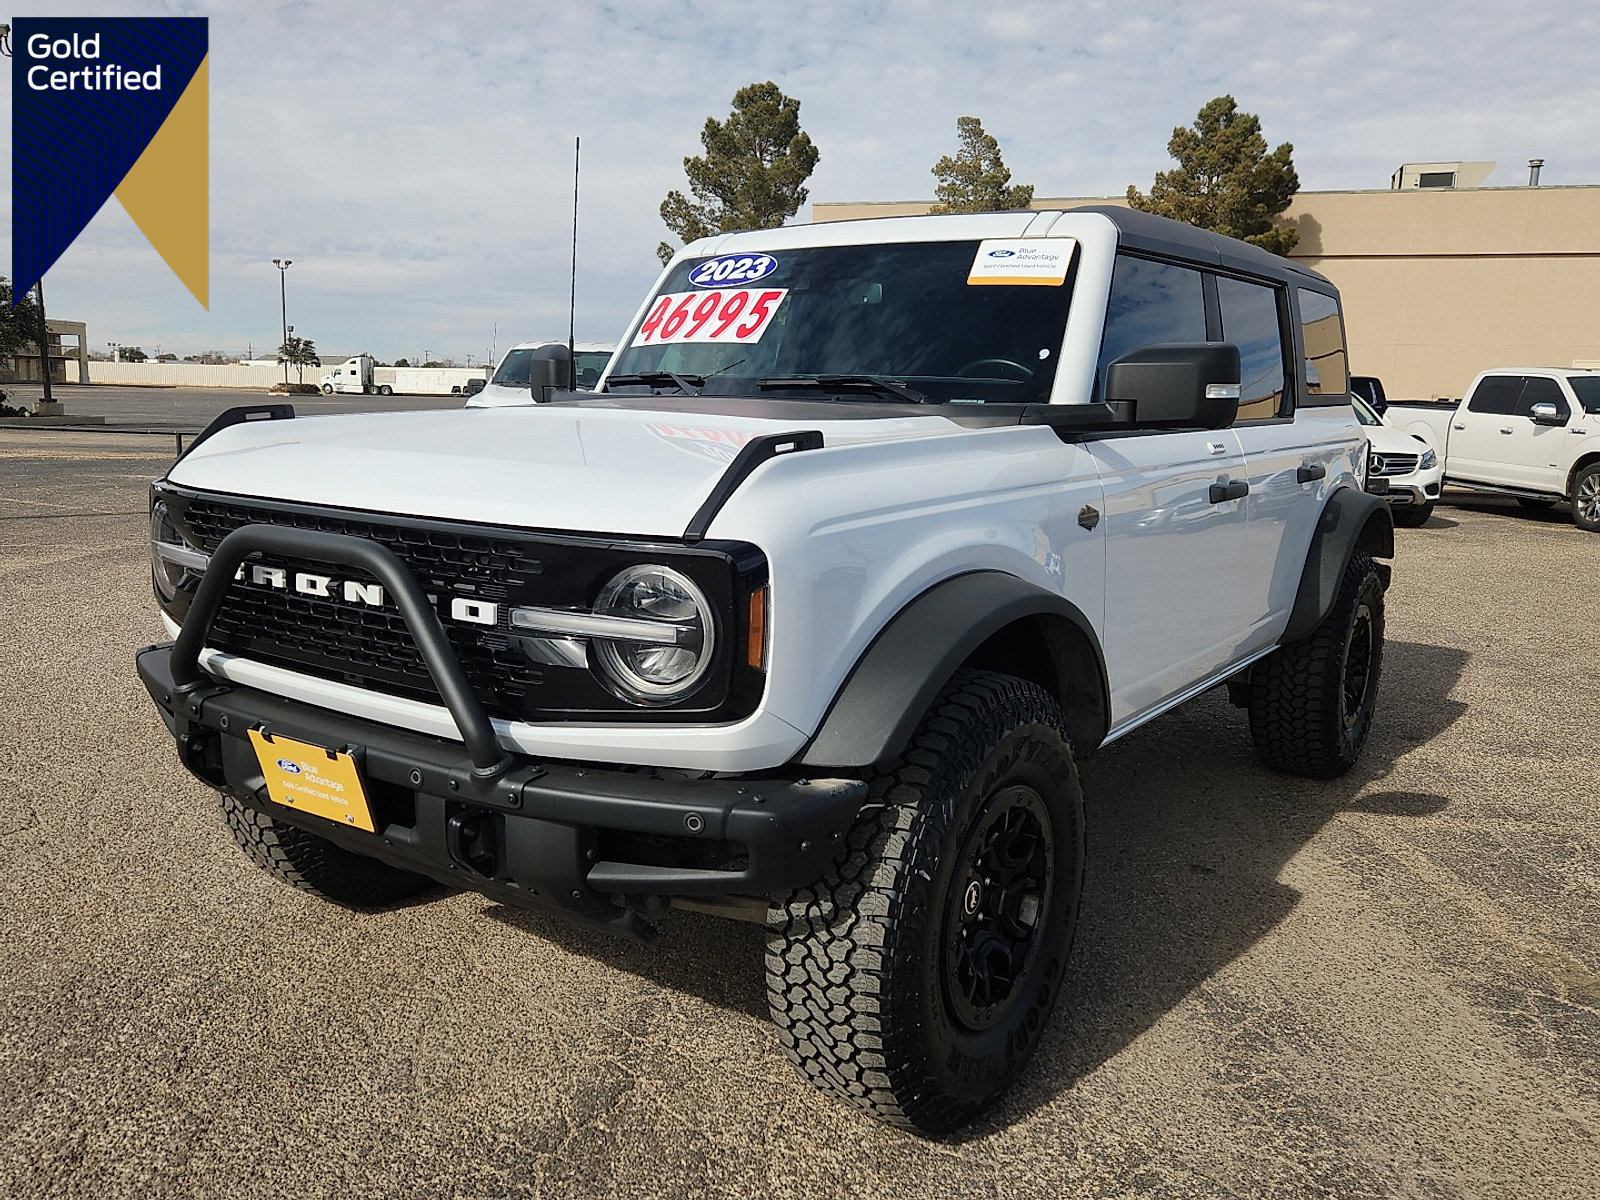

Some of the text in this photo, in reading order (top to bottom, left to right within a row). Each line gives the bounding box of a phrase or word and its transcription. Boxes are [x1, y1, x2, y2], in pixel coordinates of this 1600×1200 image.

[693, 256, 771, 283] 2023
[641, 291, 783, 342] 46995
[301, 761, 319, 775] Blue
[304, 772, 344, 792] Advantage
